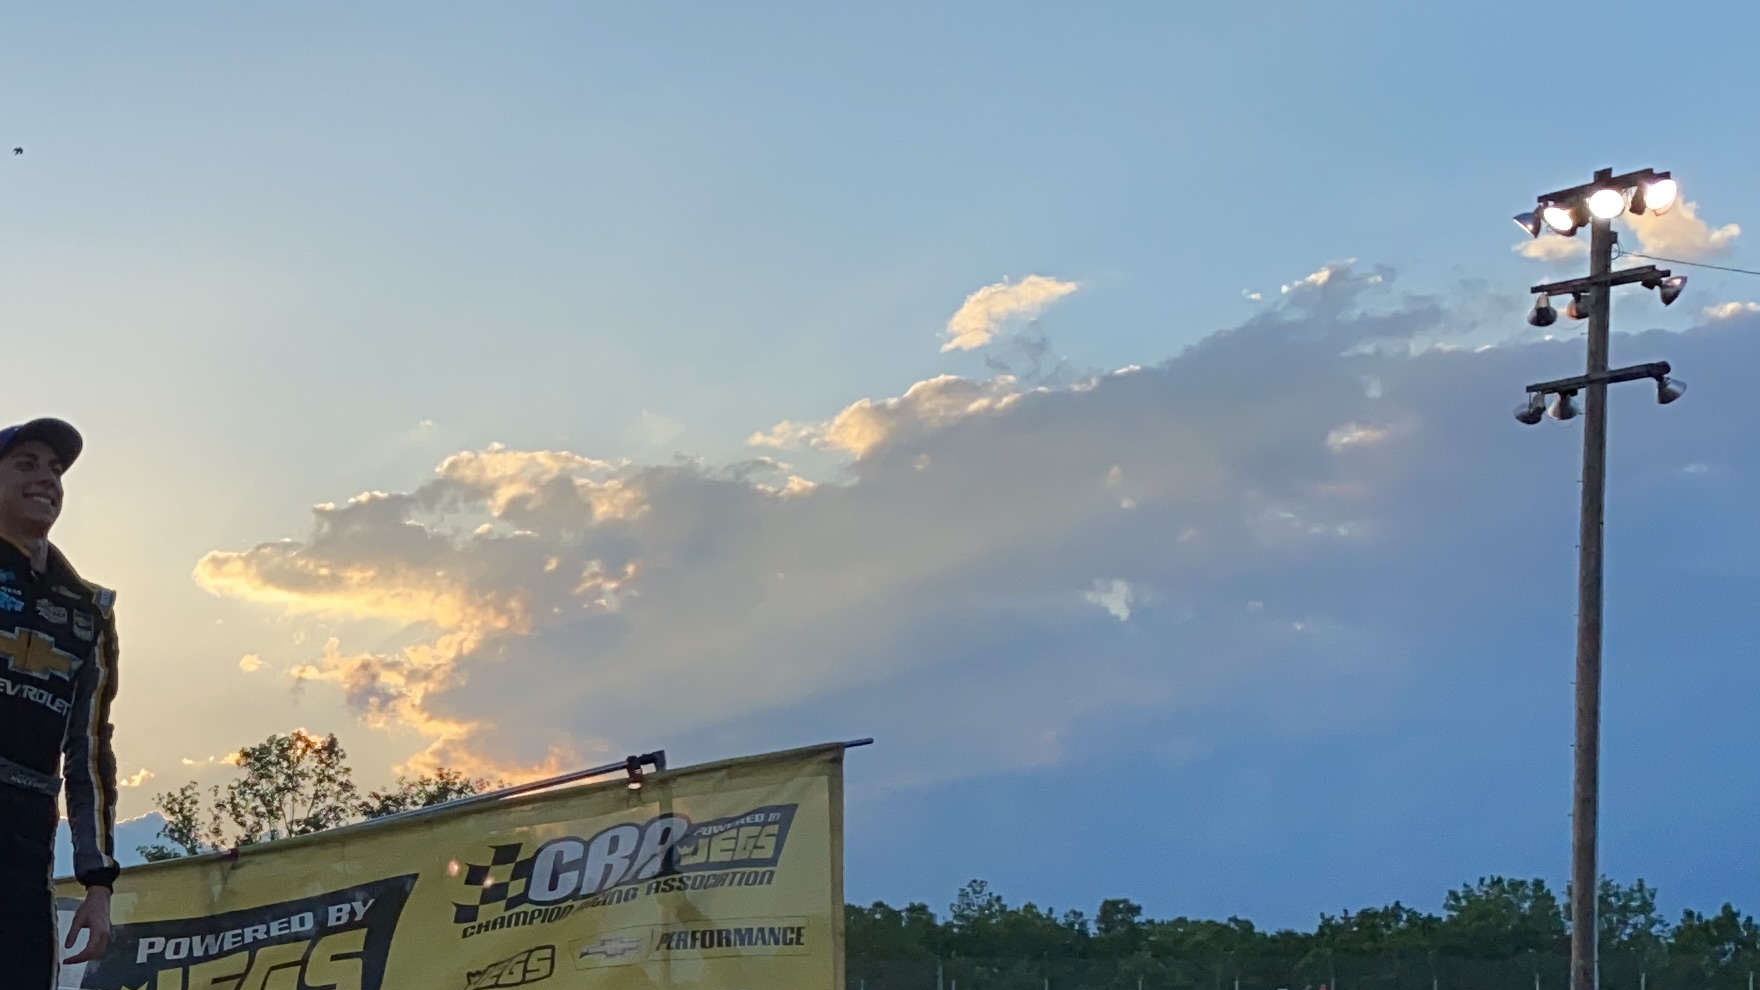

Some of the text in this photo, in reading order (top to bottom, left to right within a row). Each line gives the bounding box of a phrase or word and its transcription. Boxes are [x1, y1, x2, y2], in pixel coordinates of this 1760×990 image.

[528, 817, 688, 901] CRA
[678, 825, 779, 866] JEGS
[136, 899, 374, 963] POWERED BY
[462, 903, 575, 938] CHAMPION
[656, 926, 806, 951] PERFORMANCE
